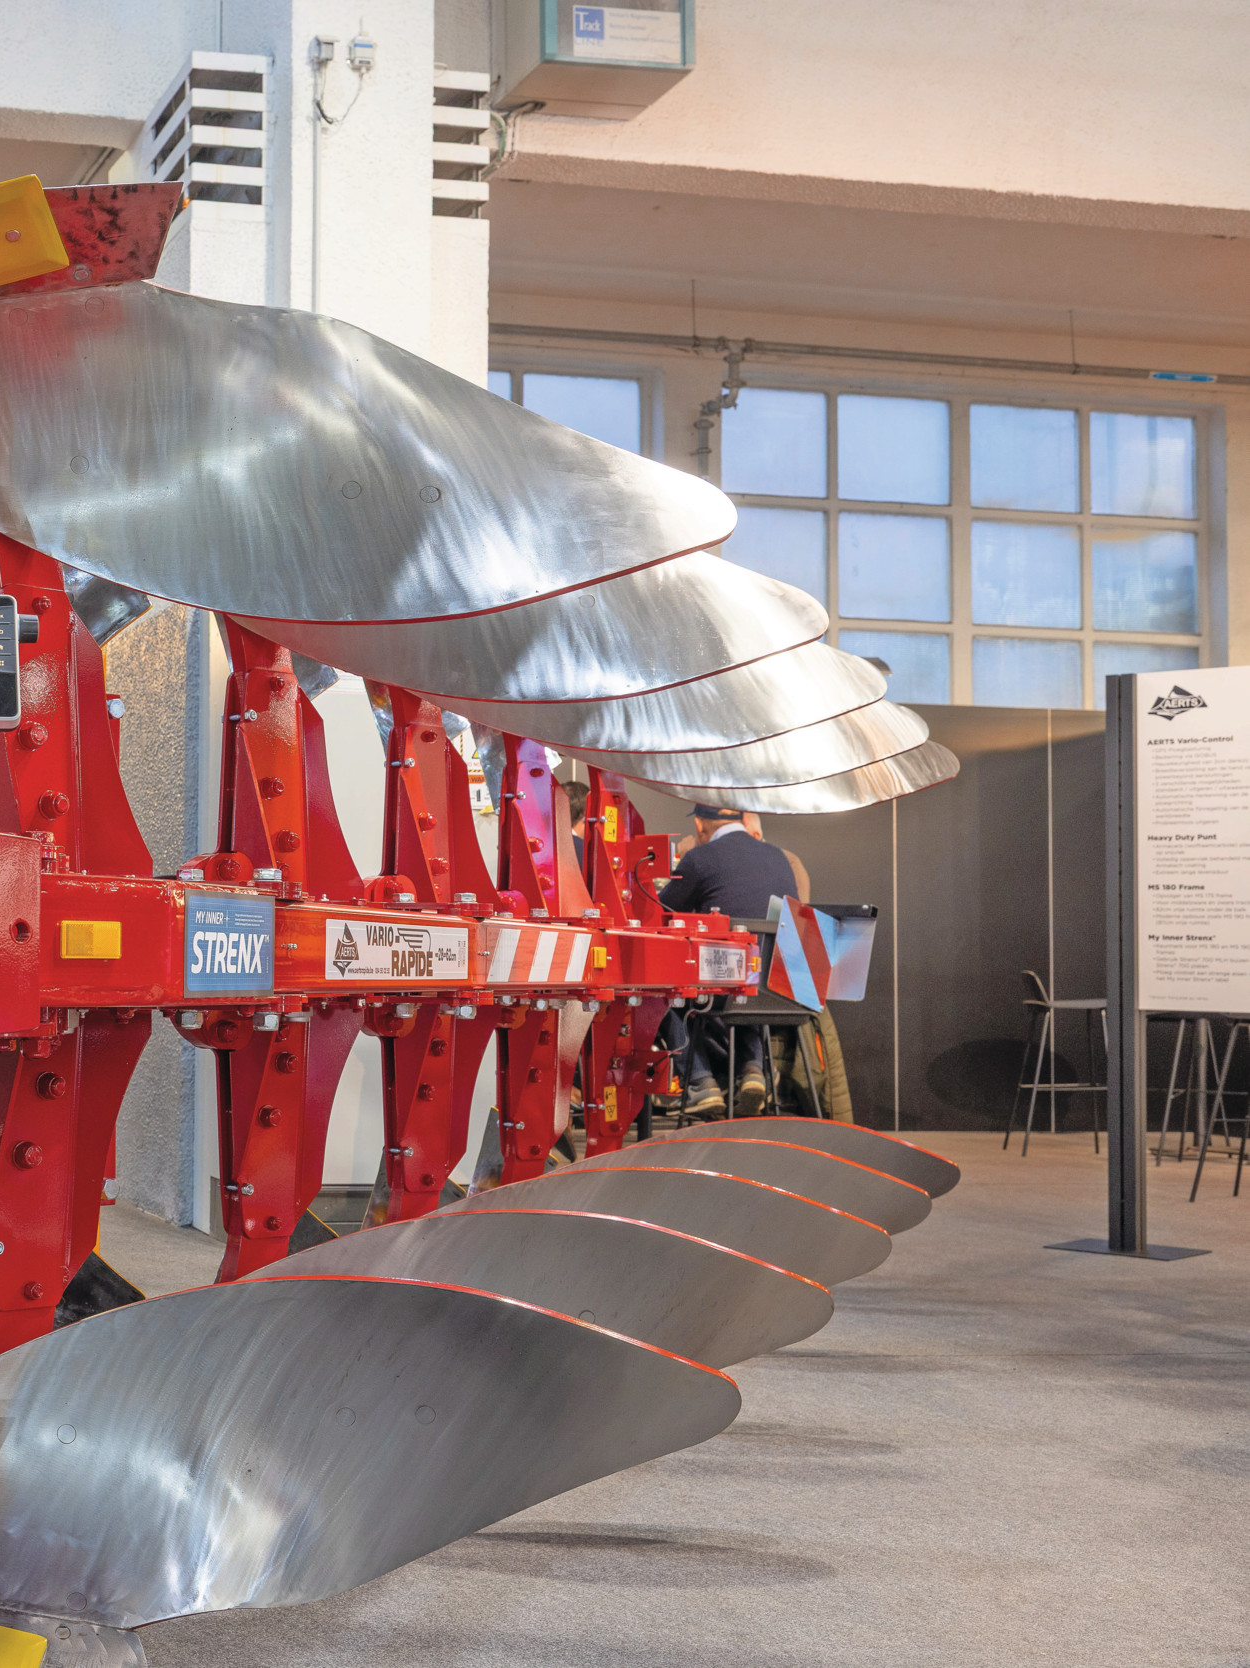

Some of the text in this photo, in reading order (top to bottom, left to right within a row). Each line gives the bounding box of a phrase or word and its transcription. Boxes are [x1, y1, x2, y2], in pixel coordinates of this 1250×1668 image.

[1163, 698, 1198, 709] AERTS
[1147, 735, 1234, 746] AERTS Vario-Control
[1175, 834, 1195, 842] Duty
[195, 911, 206, 924] MY
[205, 911, 224, 925] INNER
[1148, 934, 1160, 942] My
[341, 946, 356, 957] AERTS
[391, 950, 434, 977] RAPIDE
